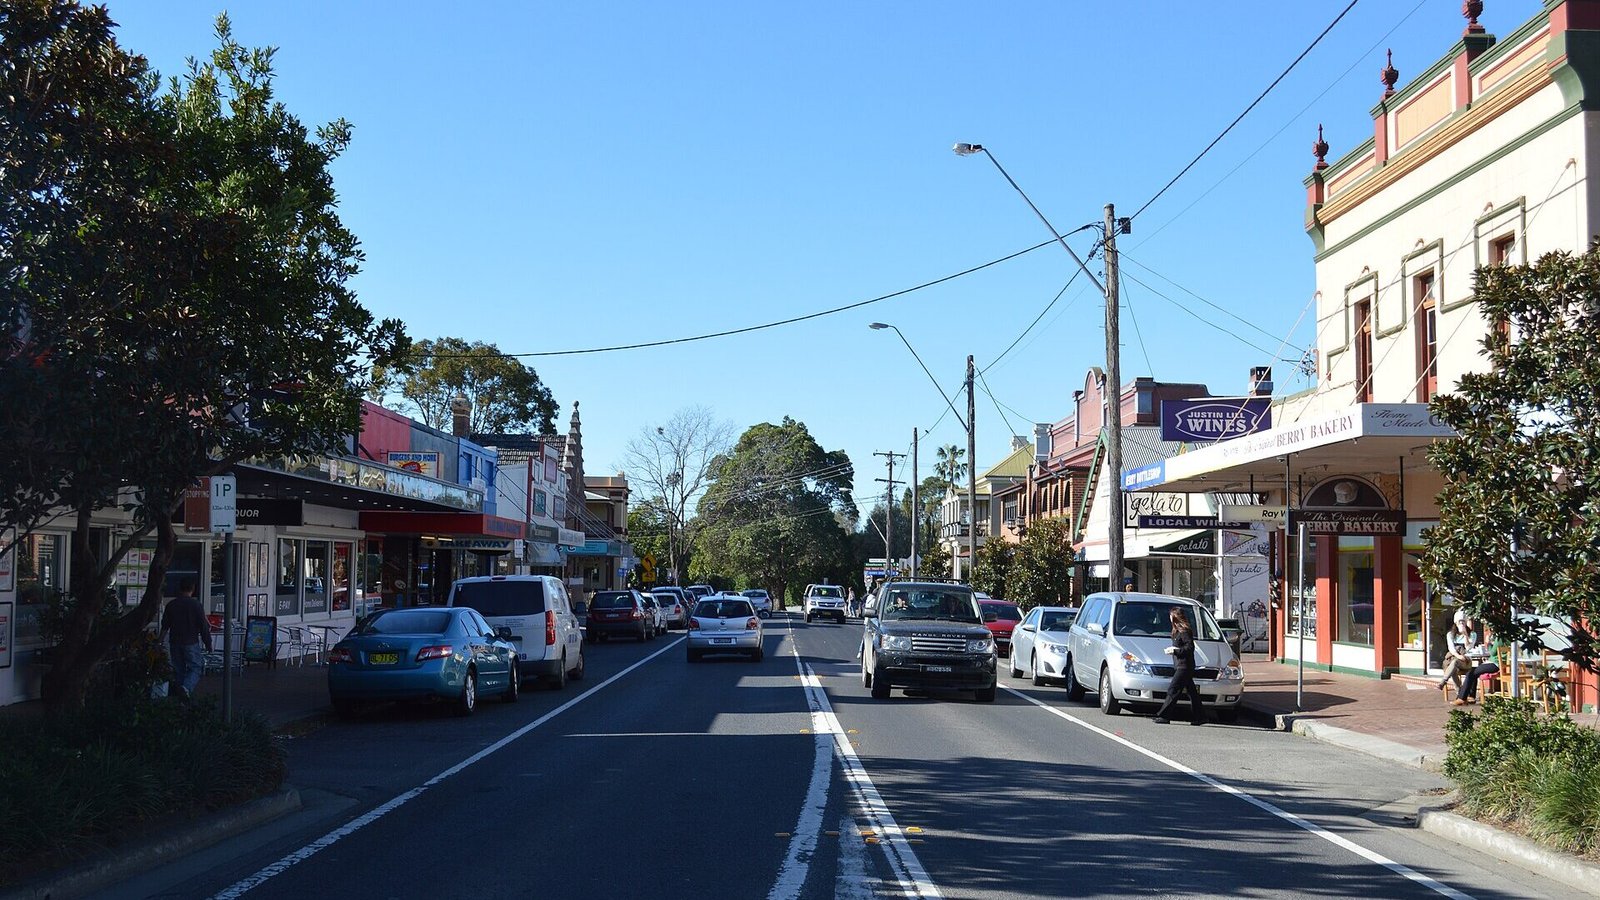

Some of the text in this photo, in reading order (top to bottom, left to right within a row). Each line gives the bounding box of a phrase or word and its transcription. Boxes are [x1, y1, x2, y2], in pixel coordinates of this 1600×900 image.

[1371, 409, 1411, 419] Home
[1187, 419, 1247, 432] WINES
[1382, 419, 1425, 428] Made
[1276, 427, 1307, 447] BERRY
[1311, 414, 1355, 438] BAKERY
[412, 454, 422, 462] AND
[423, 454, 436, 462] MORE
[186, 490, 209, 498] STOPPING
[215, 483, 232, 497] 1P
[1129, 493, 1183, 520] gelato
[236, 509, 259, 519] QUOR
[1262, 509, 1279, 519] Ray
[1303, 511, 1328, 521] The
[1148, 518, 1241, 527] LOCAL WINES
[1296, 521, 1399, 533] BERRY BAKERY
[439, 540, 511, 548] TAKEAWAY
[1178, 539, 1208, 553] gelato
[1232, 563, 1261, 577] gelato
